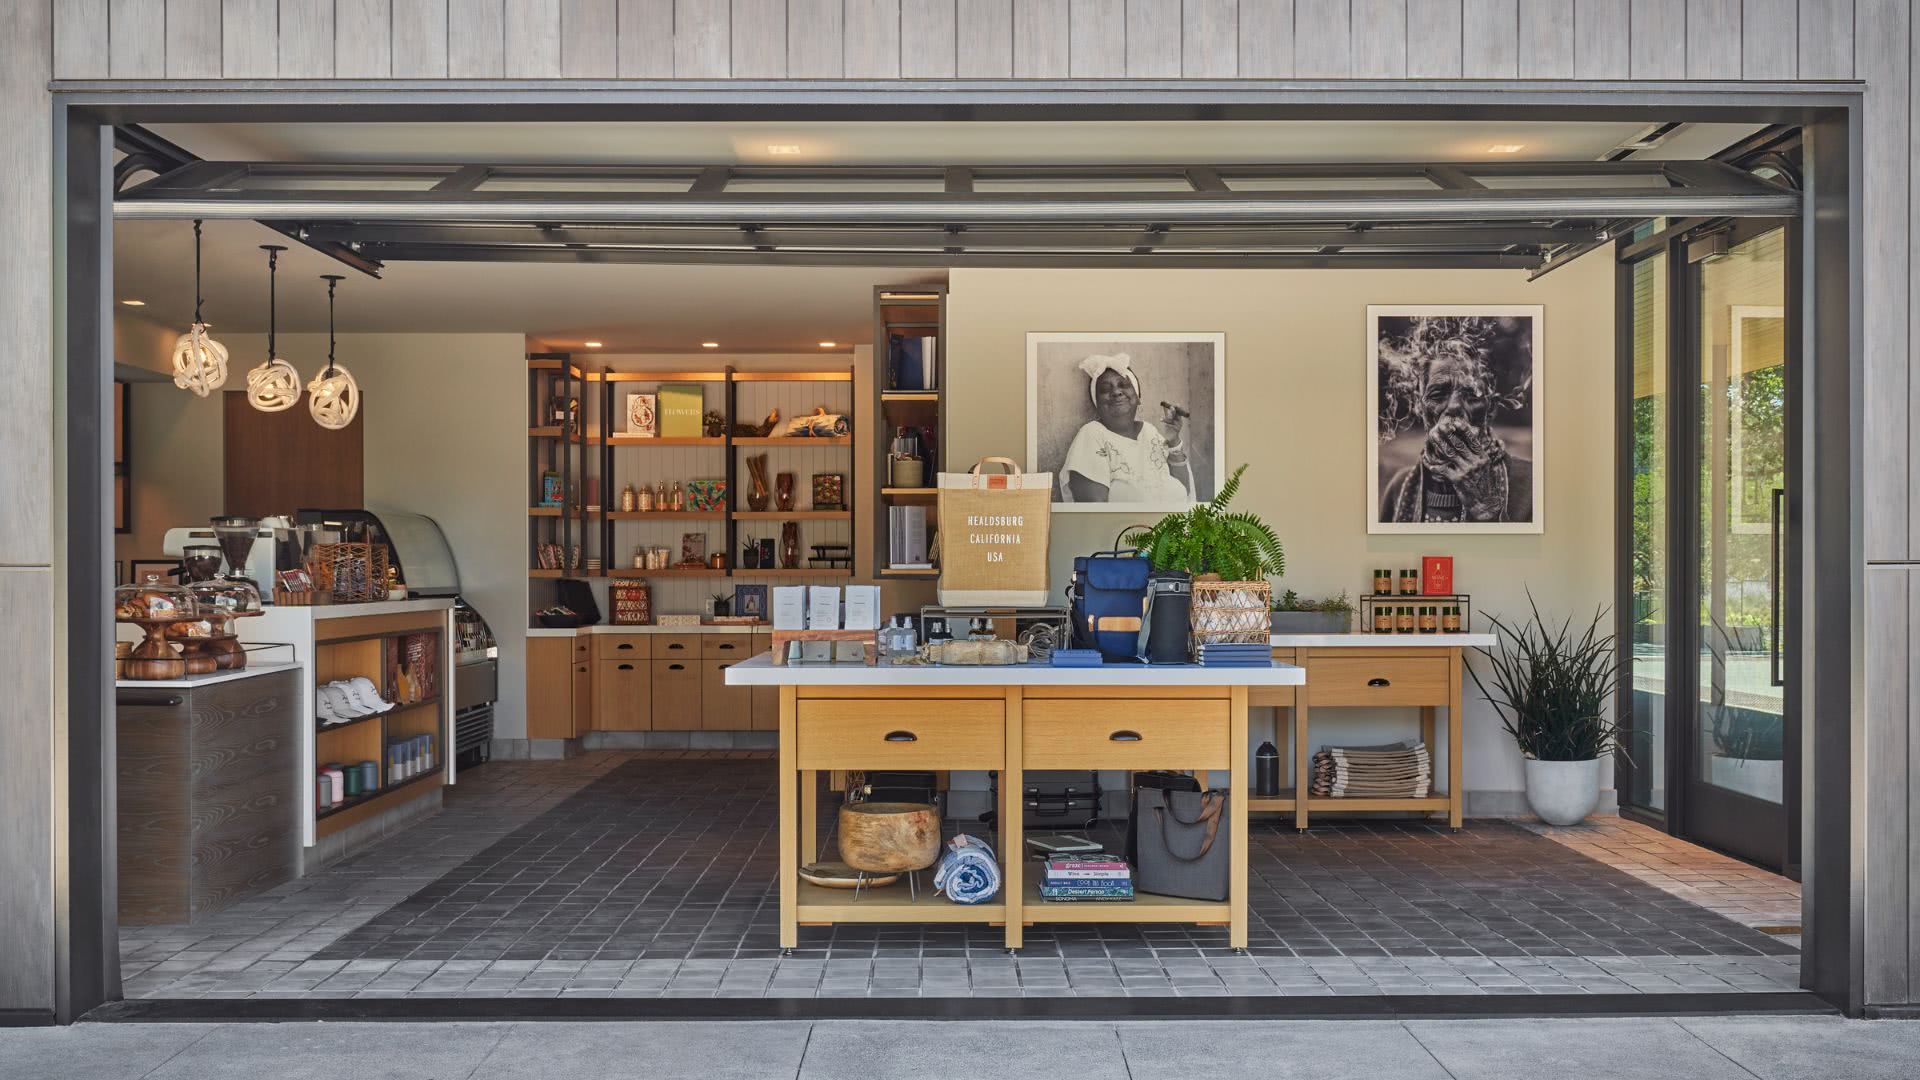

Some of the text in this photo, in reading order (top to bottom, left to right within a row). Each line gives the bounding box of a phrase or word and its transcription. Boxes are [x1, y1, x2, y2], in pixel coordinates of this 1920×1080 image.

[967, 515, 1024, 526] HEALDSBURG
[970, 533, 1021, 544] CALIFORNIA
[987, 551, 1003, 562] USA
